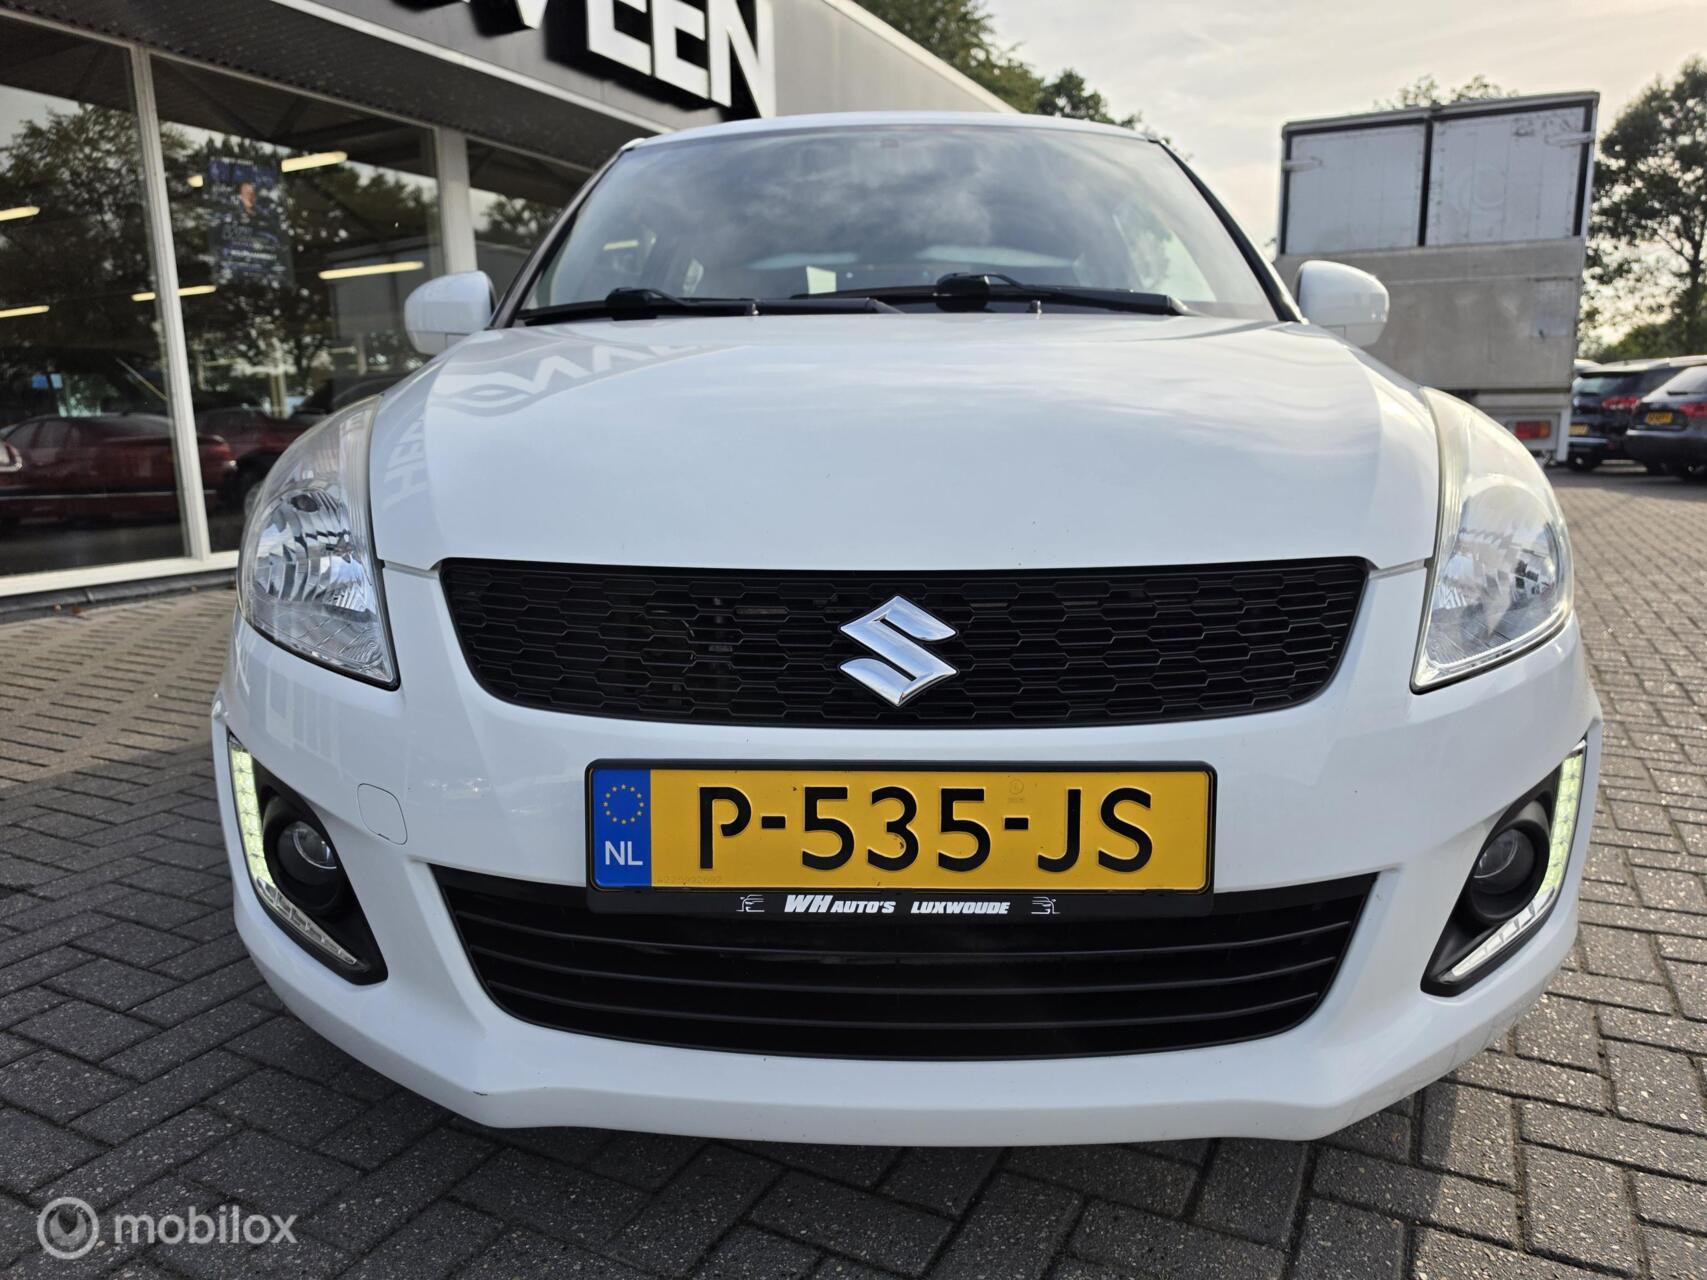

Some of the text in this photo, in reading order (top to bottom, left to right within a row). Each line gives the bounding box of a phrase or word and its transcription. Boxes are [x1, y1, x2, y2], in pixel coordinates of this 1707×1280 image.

[699, 786, 1153, 872] P-535-JS
[604, 841, 643, 865] NL
[784, 894, 1010, 915] WH AUTO'S LUXWOUDE
